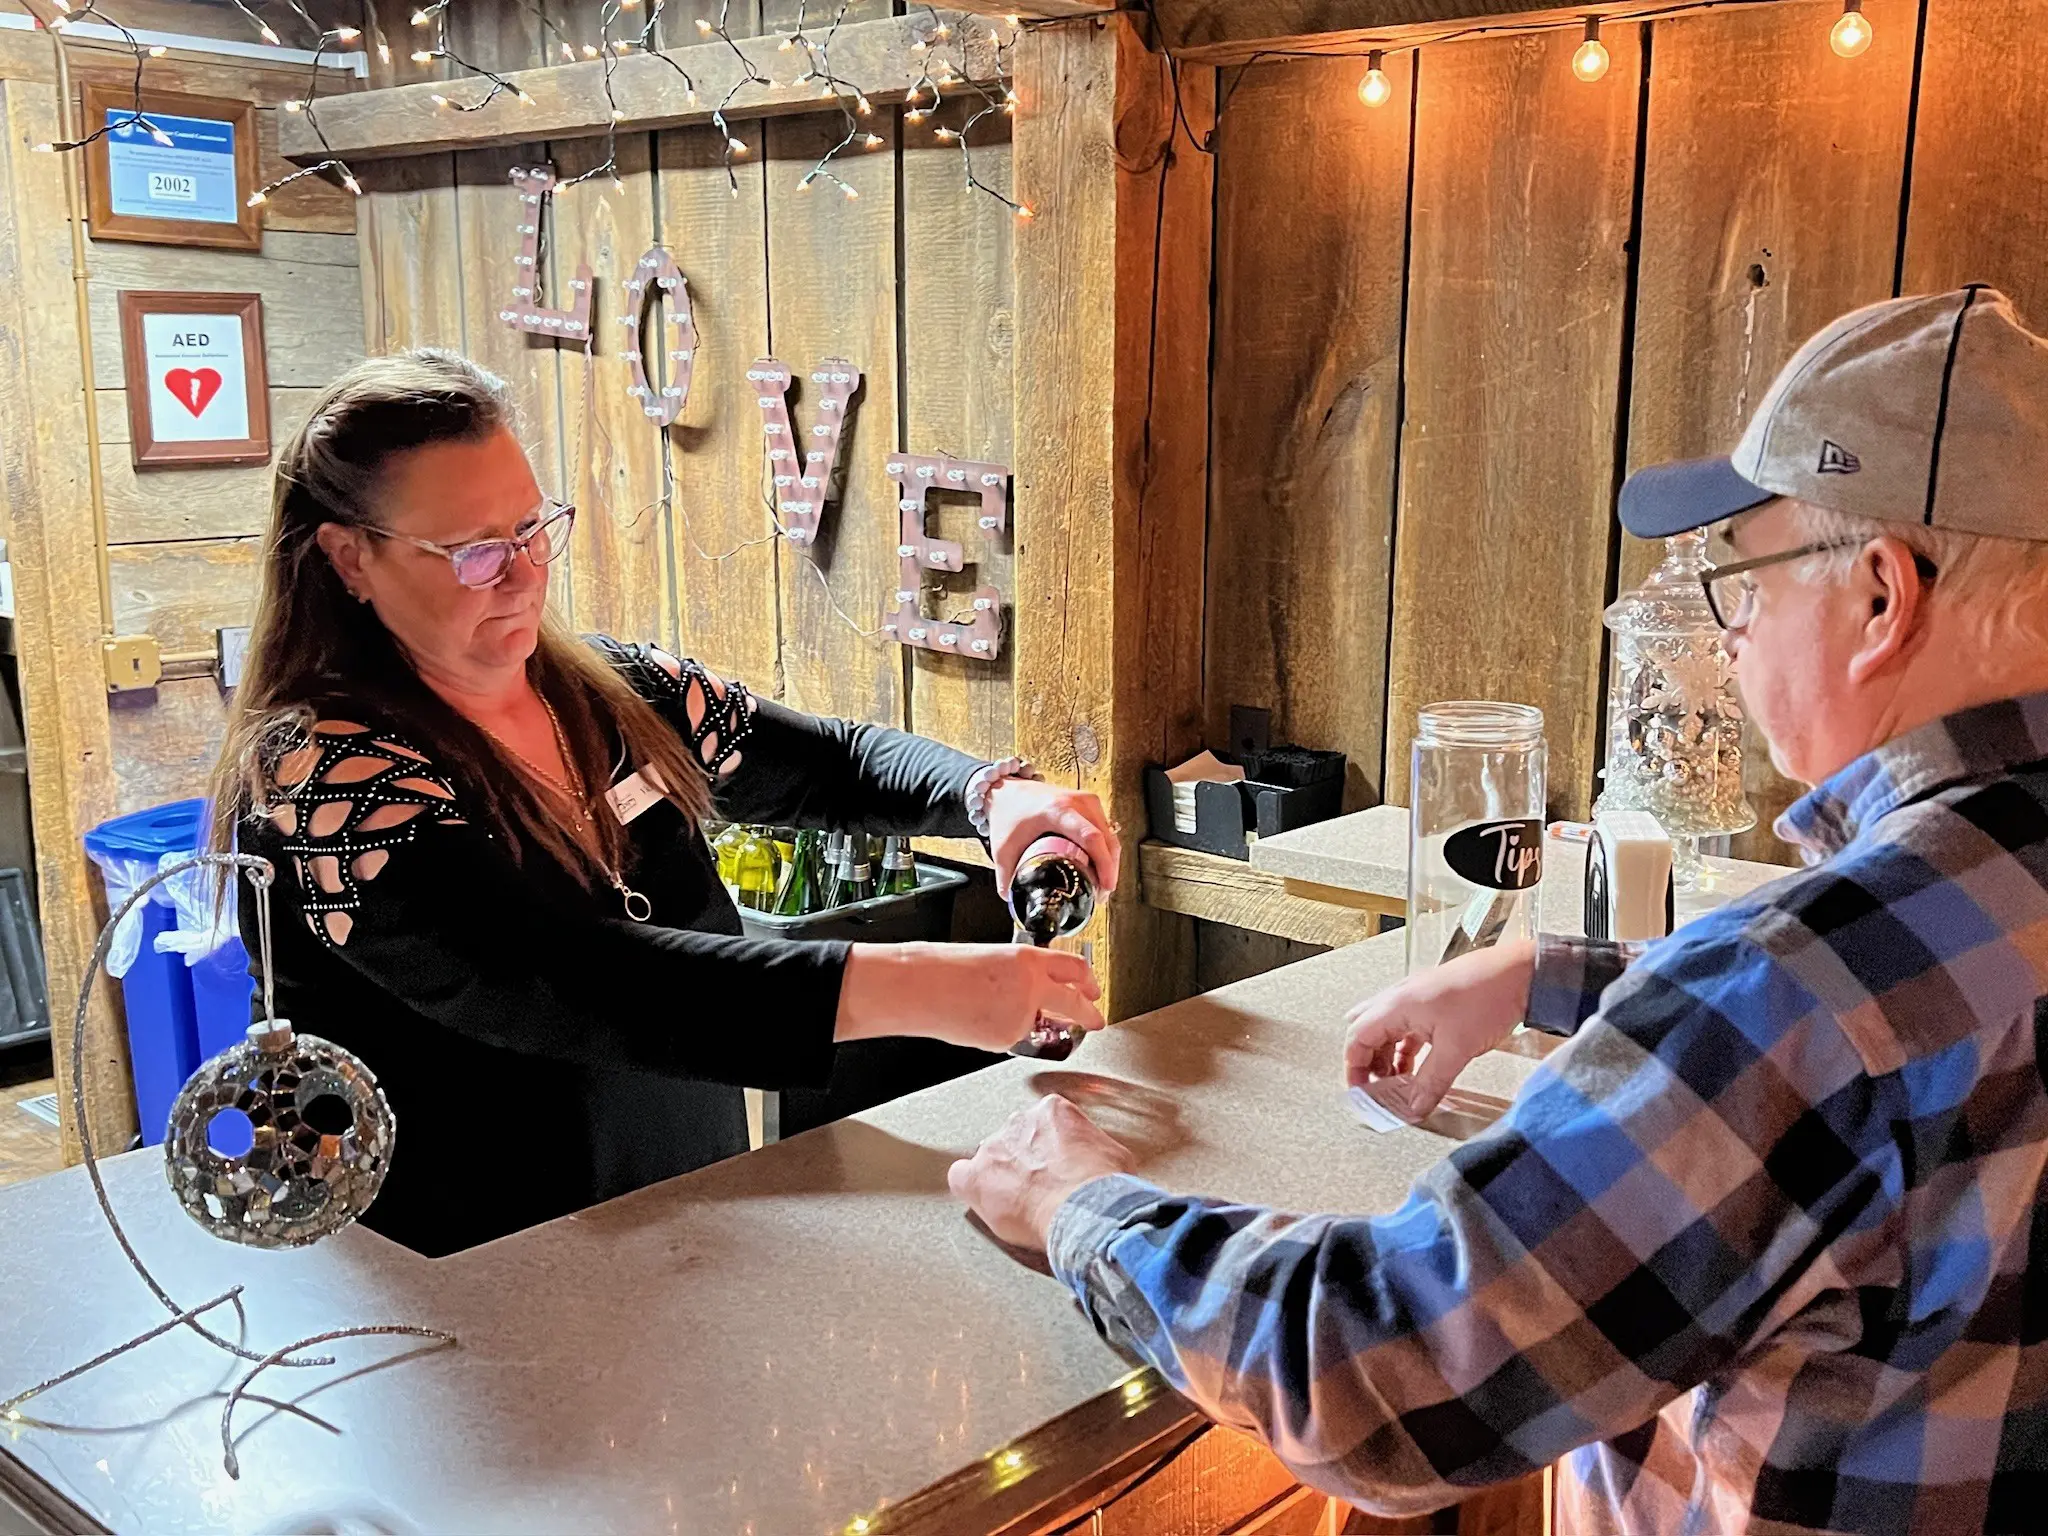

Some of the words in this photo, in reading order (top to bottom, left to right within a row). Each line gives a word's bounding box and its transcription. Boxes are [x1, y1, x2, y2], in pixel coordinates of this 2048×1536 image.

[154, 175, 190, 193] 2002
[172, 333, 210, 347] AED
[501, 166, 1008, 661] LOVE
